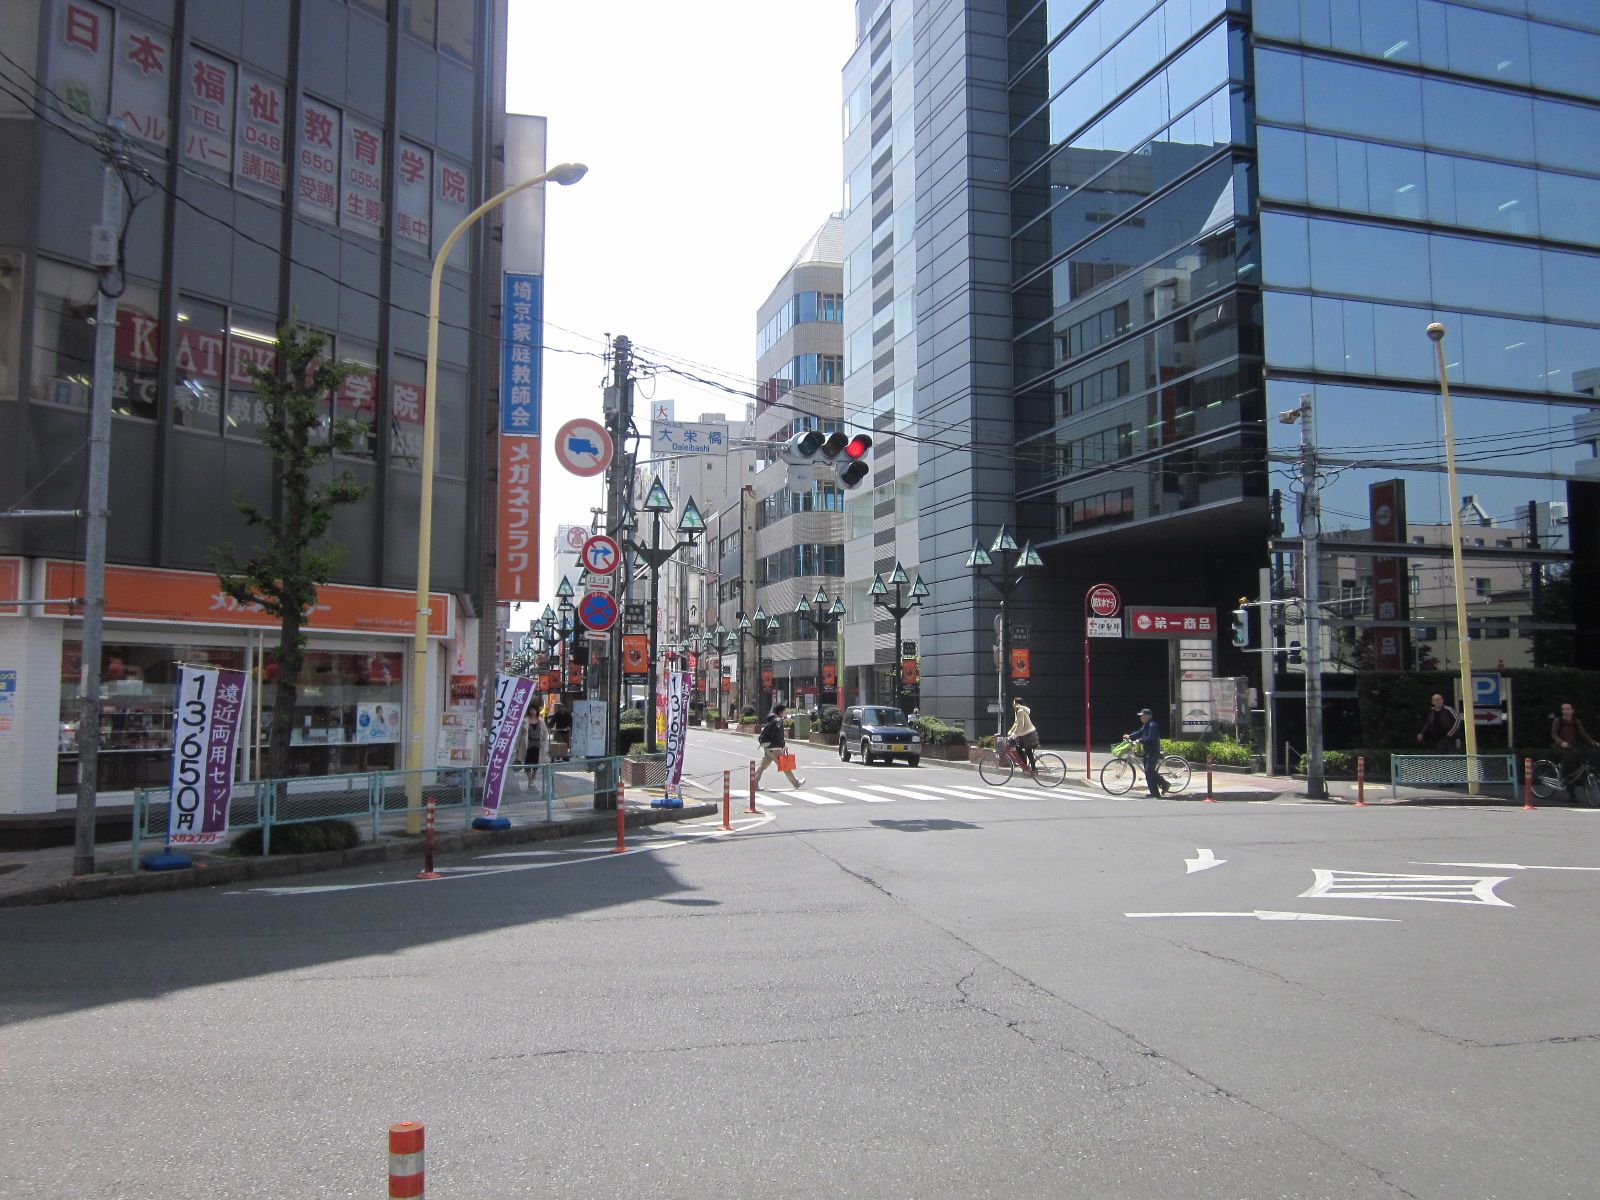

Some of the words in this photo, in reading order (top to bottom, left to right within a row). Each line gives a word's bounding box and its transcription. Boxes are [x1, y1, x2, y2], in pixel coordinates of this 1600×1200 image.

[190, 108, 226, 133] TEL
[244, 128, 281, 152] 048
[302, 150, 334, 174] 650
[350, 167, 380, 191] 0554
[511, 280, 533, 427] 埼京家庭教師会
[658, 428, 722, 445] 大栄橋
[508, 444, 530, 595] メガネフラワー
[1154, 616, 1211, 630] 第一商品
[1474, 677, 1497, 702] P
[176, 674, 207, 831] 13,650円
[208, 683, 241, 822] 遠近両用セット
